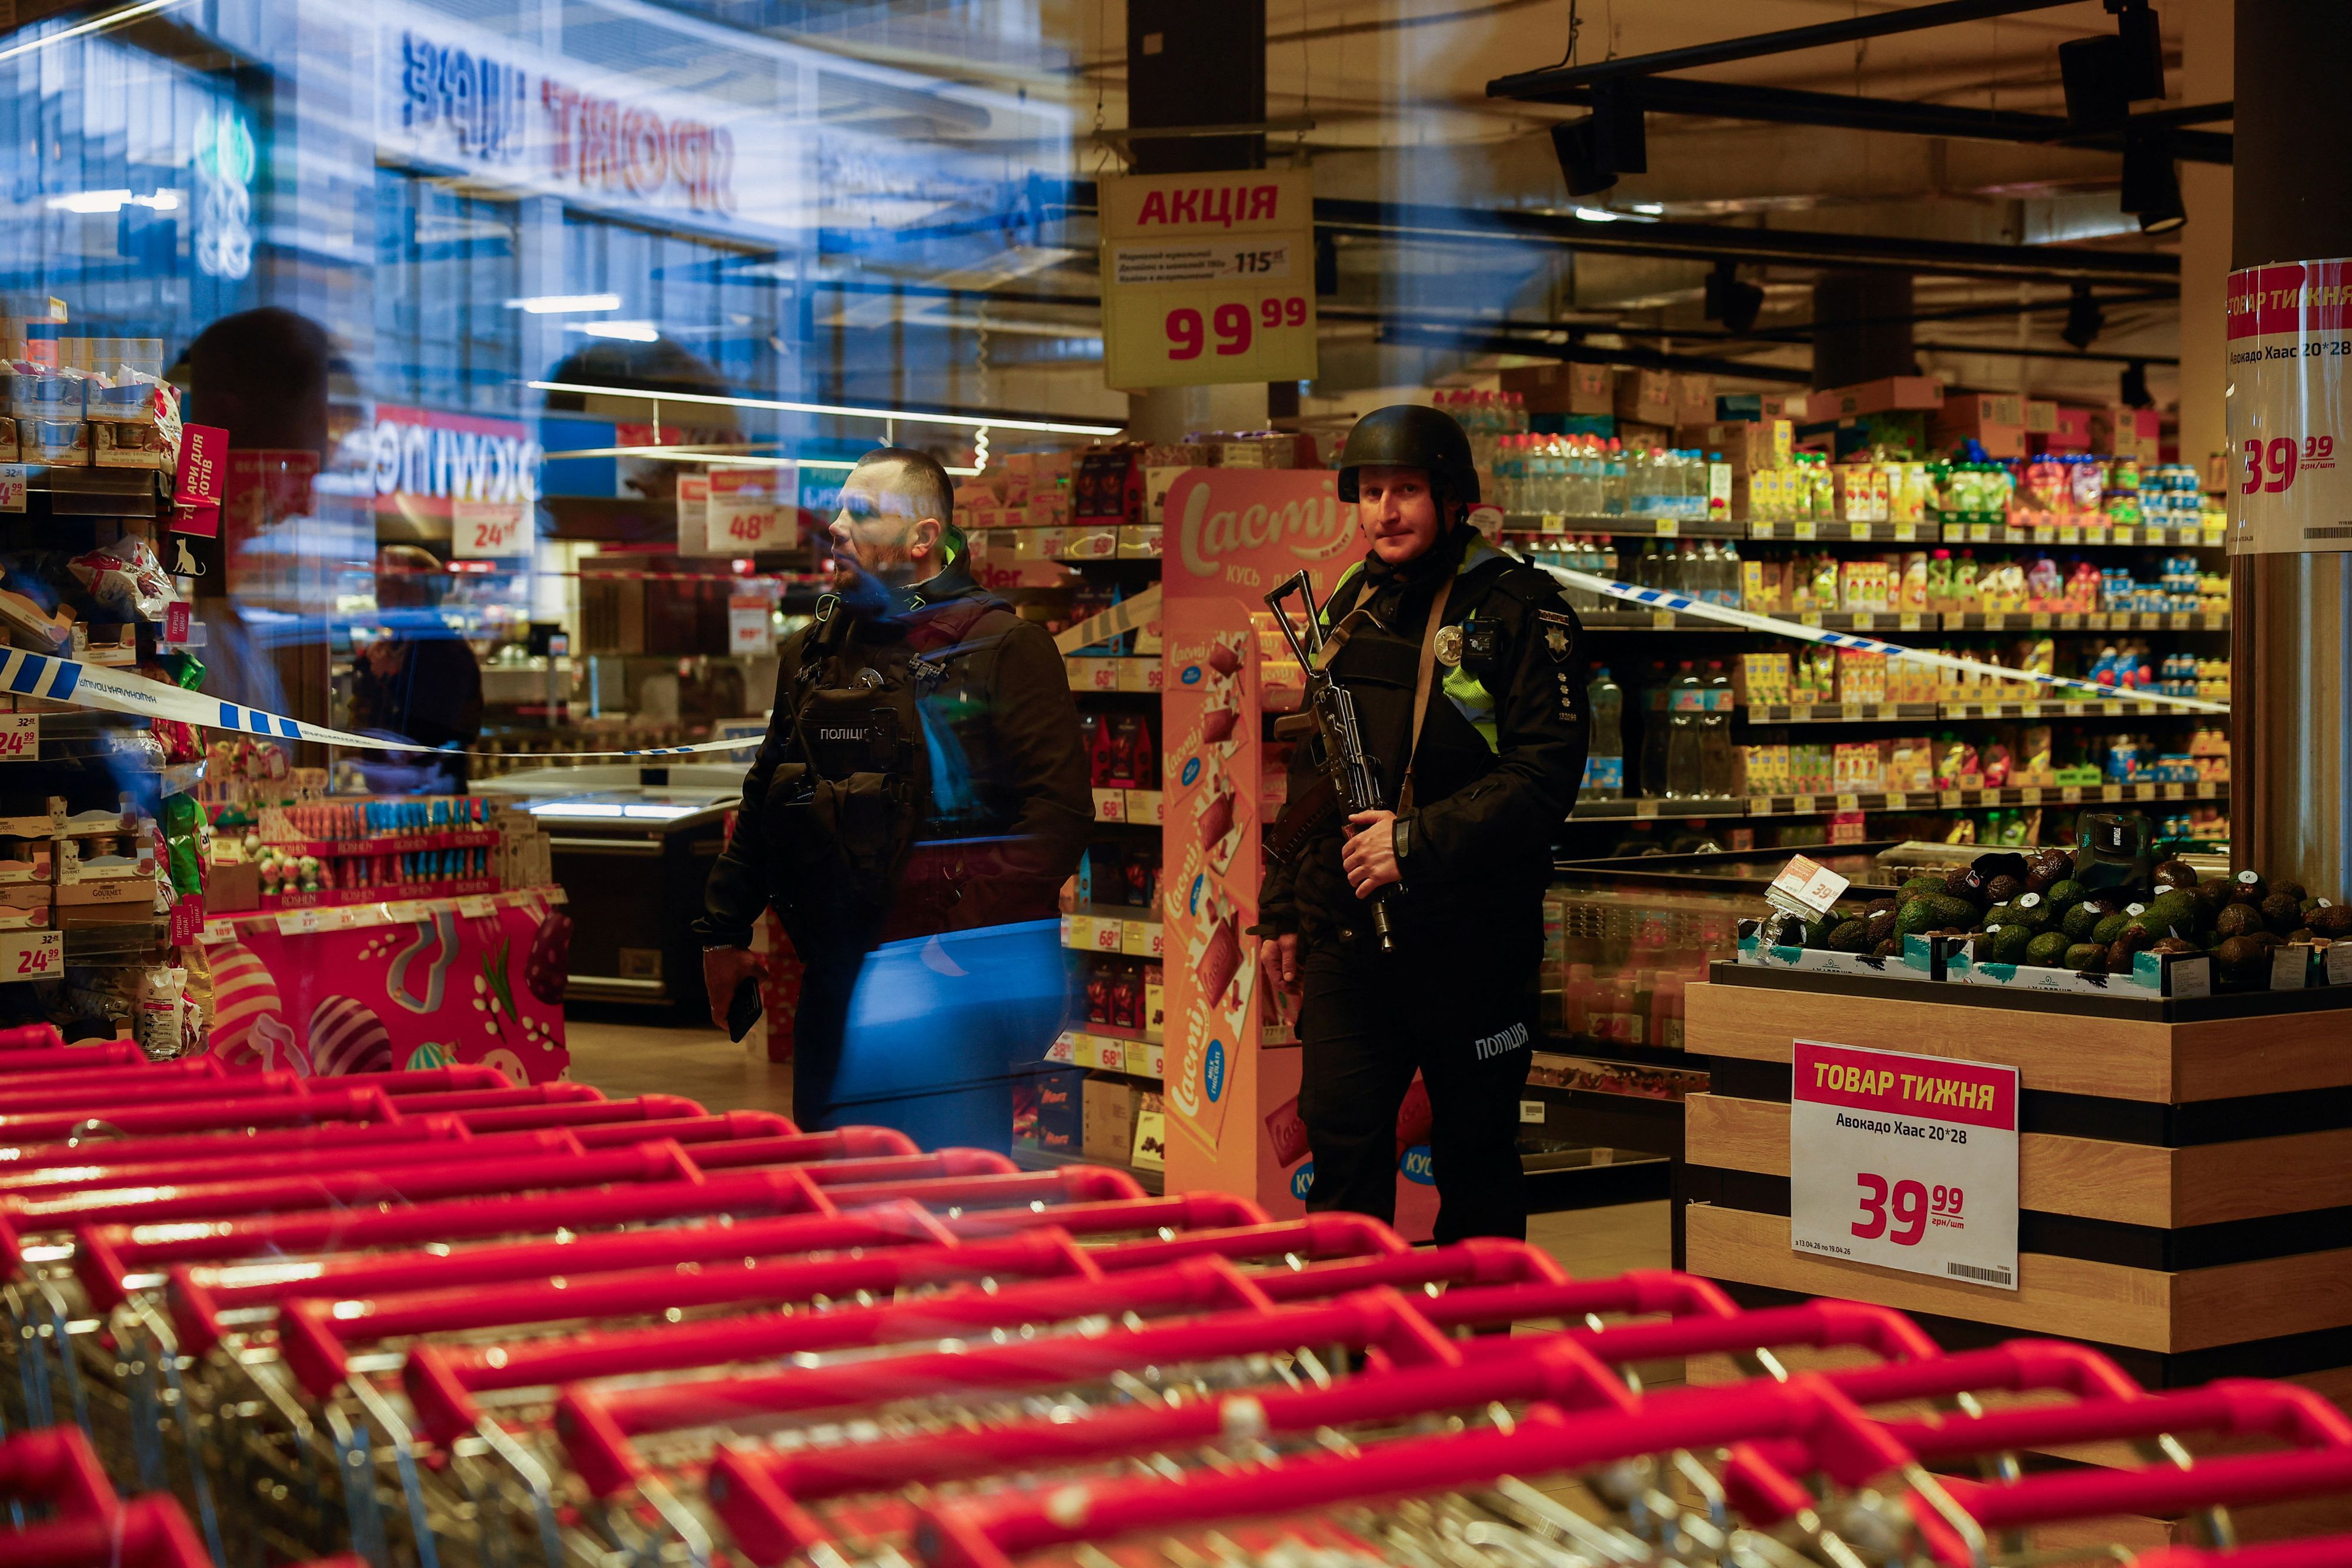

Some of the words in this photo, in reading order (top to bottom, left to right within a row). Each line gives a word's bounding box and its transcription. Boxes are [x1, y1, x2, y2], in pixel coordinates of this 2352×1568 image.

[1137, 185, 1278, 228] АКЦІЯ
[1235, 252, 1271, 273] 115
[2229, 292, 2267, 317] ТОВАР
[1166, 303, 1252, 360] 99
[1261, 297, 1307, 327] 99
[2230, 350, 2263, 365] Авокадо
[2265, 346, 2297, 359] Хаас
[191, 433, 203, 465] ДЛЯ
[2242, 437, 2297, 494] 39
[2301, 436, 2333, 457] 99
[2301, 462, 2335, 470] грн/шт
[0, 483, 10, 504] 4
[475, 524, 502, 546] 24
[729, 515, 761, 540] 48
[1180, 479, 1337, 578] Lacmi
[1226, 564, 1261, 587] КУСЬ
[79, 678, 107, 692] ПОЛІЦІЯ
[107, 685, 157, 703] НАЦІОНАЛЬНА
[1100, 930, 1114, 946] 68
[18, 950, 47, 973] 24
[1475, 1022, 1529, 1060] ПОЛІЦІЯ
[1102, 1049, 1117, 1065] 68
[1171, 1007, 1204, 1116] Lacmi
[1211, 1051, 1221, 1094] CHOCOLATE
[1814, 1062, 1894, 1096] ТОВАР
[1900, 1073, 1995, 1111] ТИЖНЯ
[1836, 1112, 1891, 1134] Авокадо
[1893, 1121, 1925, 1138] Хаас
[1406, 1152, 1434, 1177] КУС
[1296, 1173, 1314, 1193] КУ
[1851, 1173, 1928, 1246] 39
[1932, 1185, 1964, 1214] 99
[1932, 1218, 1965, 1229] грн/шт
[1799, 1240, 1820, 1249] 13.04.26
[1829, 1245, 1850, 1255] 19.04.26
